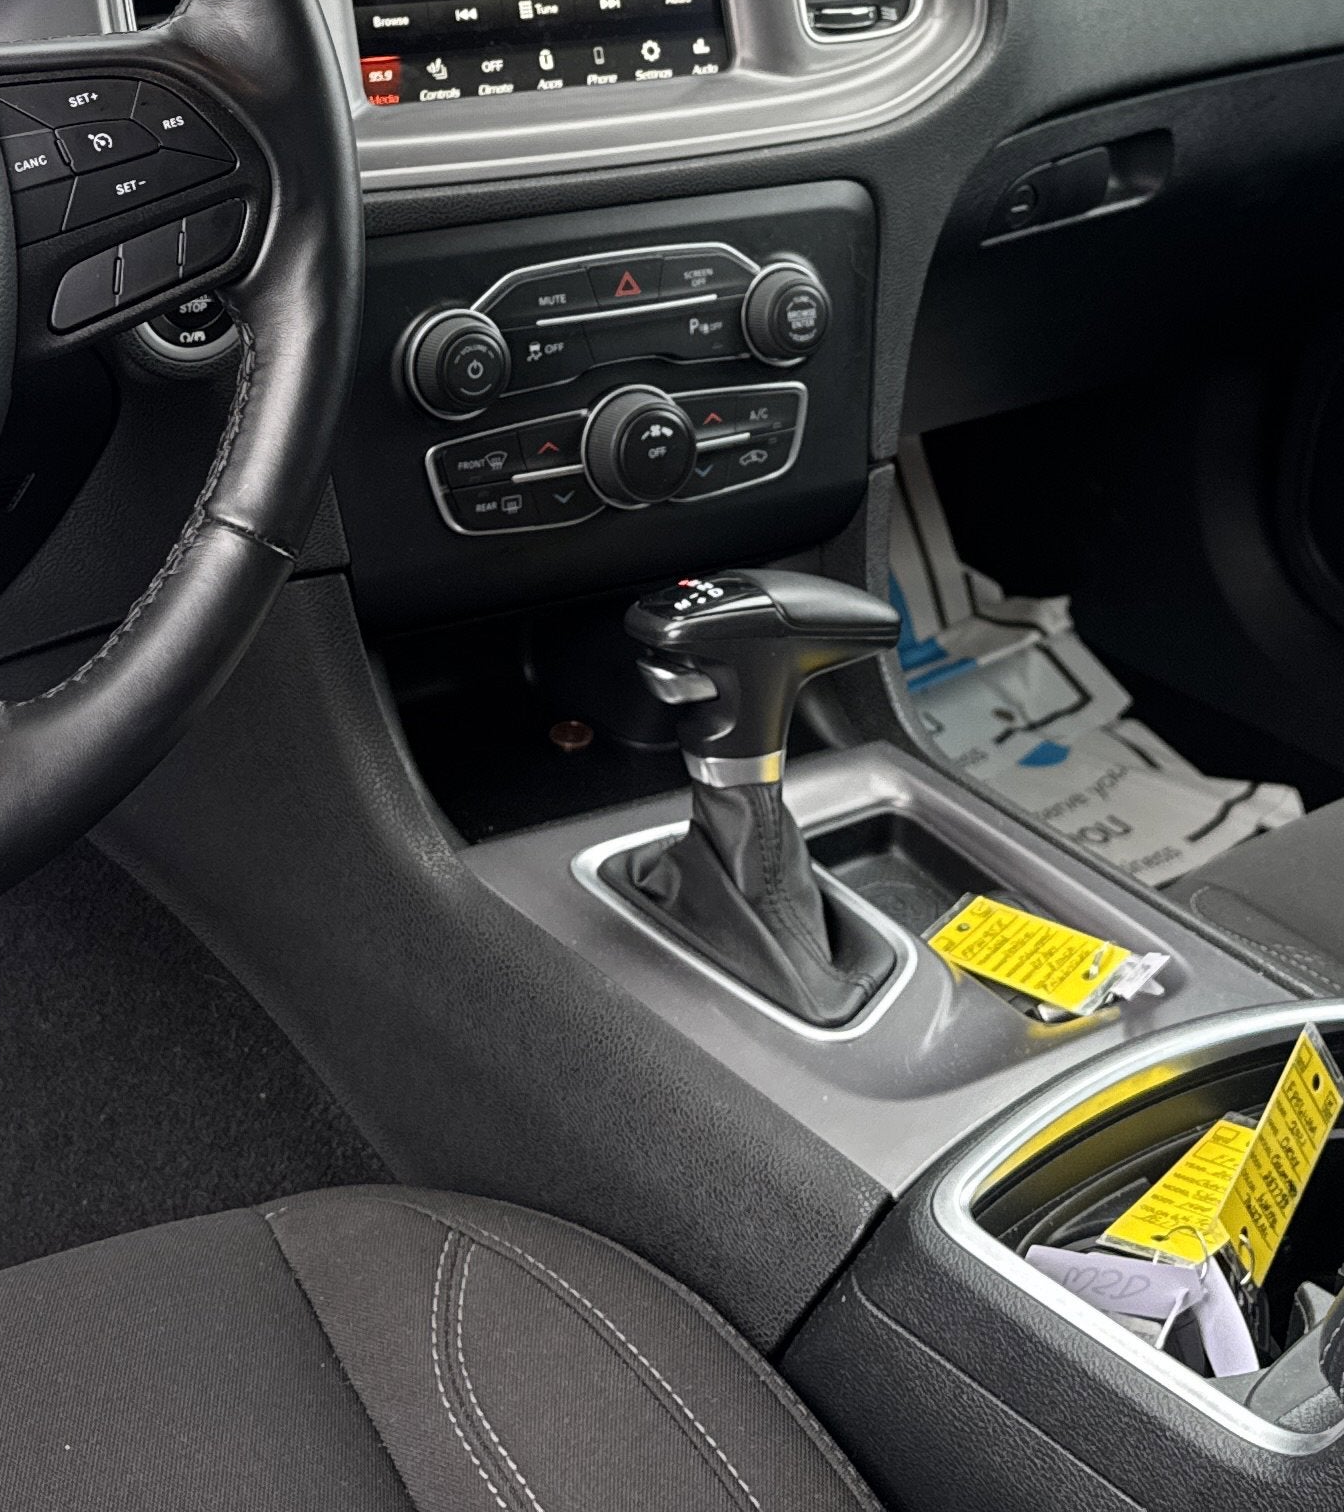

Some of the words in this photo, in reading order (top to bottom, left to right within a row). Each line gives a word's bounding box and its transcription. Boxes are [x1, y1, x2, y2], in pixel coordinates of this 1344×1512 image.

[534, 2, 559, 15] Tune
[372, 15, 410, 29] Browse
[481, 59, 504, 73] OFF
[692, 63, 719, 76] Audio
[587, 73, 618, 86] Phone
[635, 68, 673, 82] Settings
[419, 87, 461, 102] Controls
[478, 83, 514, 96] Climate
[162, 115, 185, 130] RES
[14, 154, 48, 173] CANC
[538, 293, 567, 306] MUTE
[179, 301, 208, 314] STOP
[544, 342, 564, 355] OFF
[648, 446, 667, 459] OFF
[458, 457, 486, 471] FRONT
[475, 501, 498, 513] REAR
